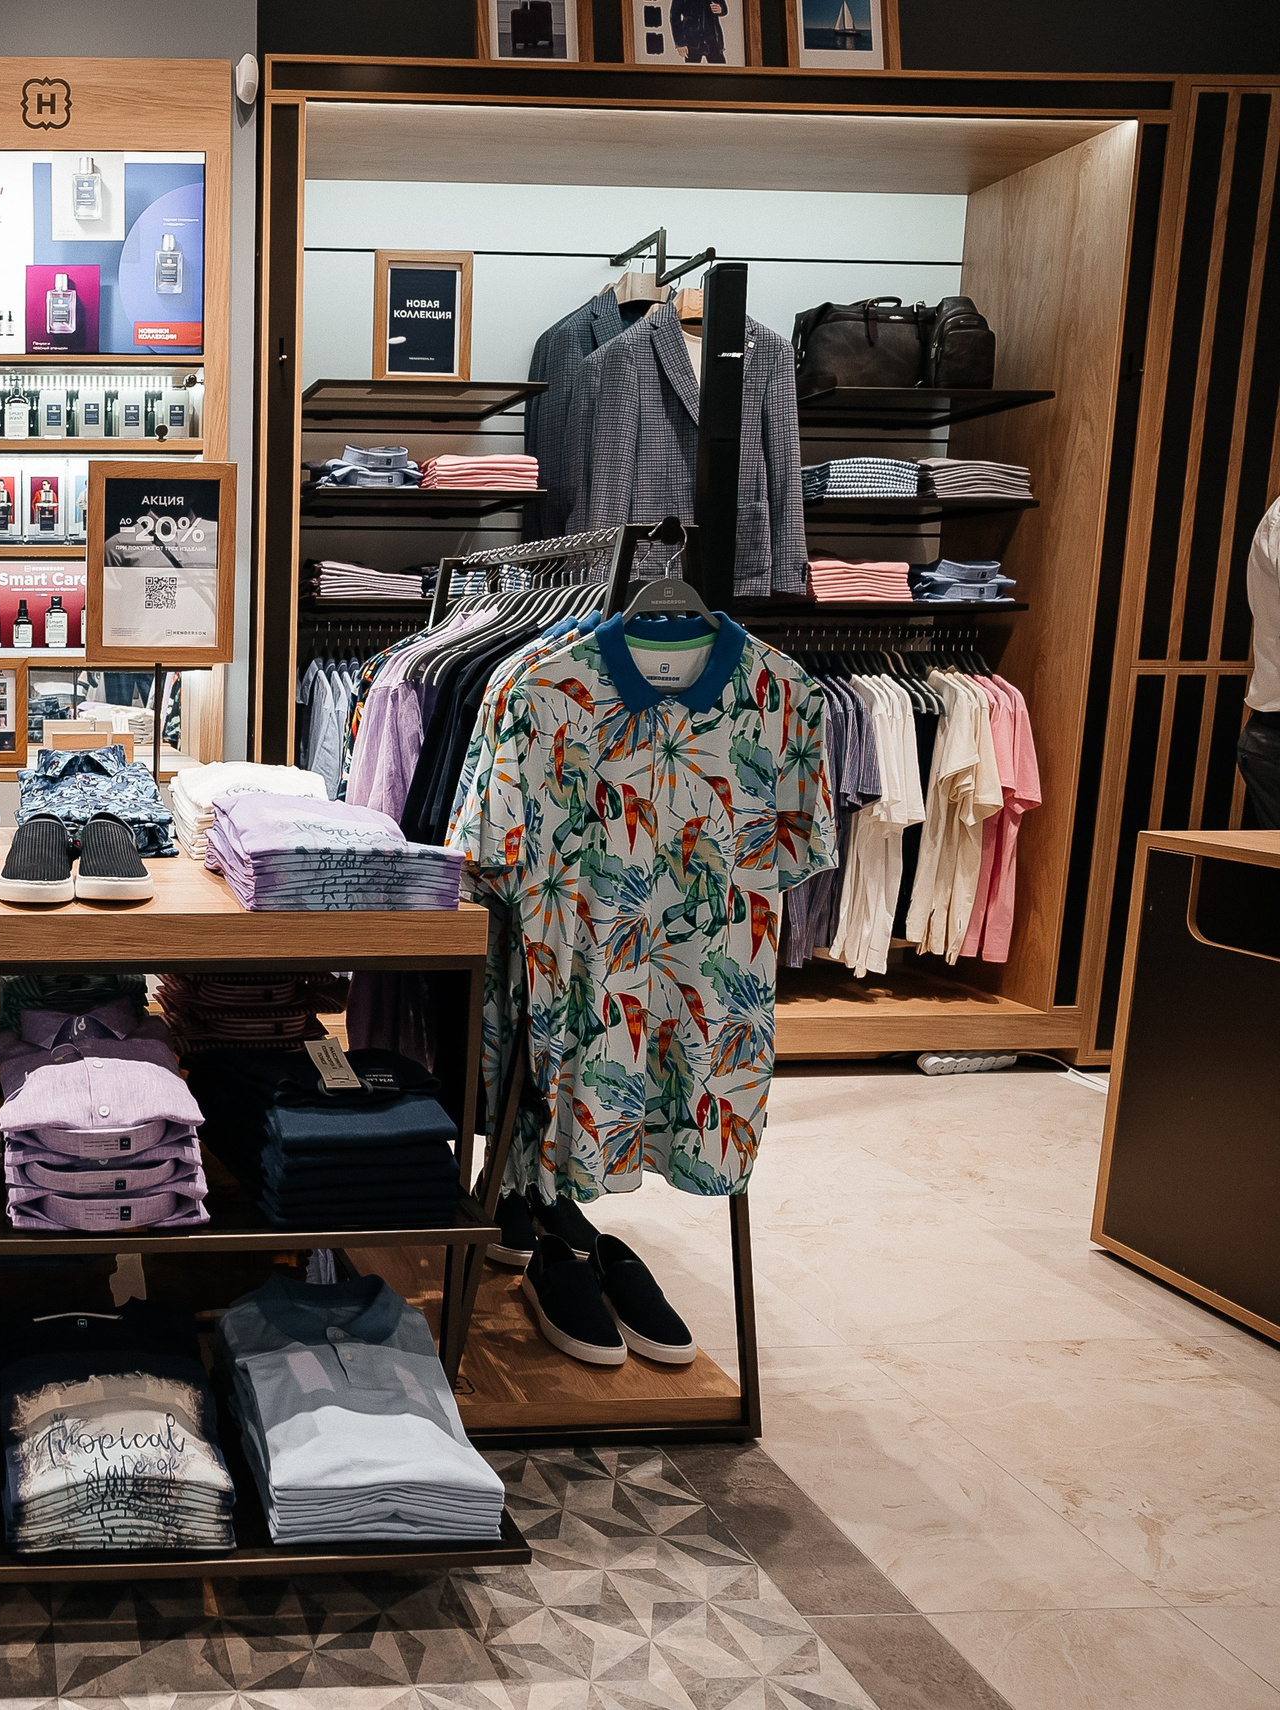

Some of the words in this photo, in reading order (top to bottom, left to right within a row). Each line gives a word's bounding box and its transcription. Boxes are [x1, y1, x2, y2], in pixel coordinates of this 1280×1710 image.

[37, 93, 56, 114] H
[406, 300, 440, 308] НОВАЯ
[394, 310, 452, 320] КОЛЛЕКЦИЯ
[141, 496, 184, 507] АКЦИЯ
[36, 1413, 186, 1467] Tropical
